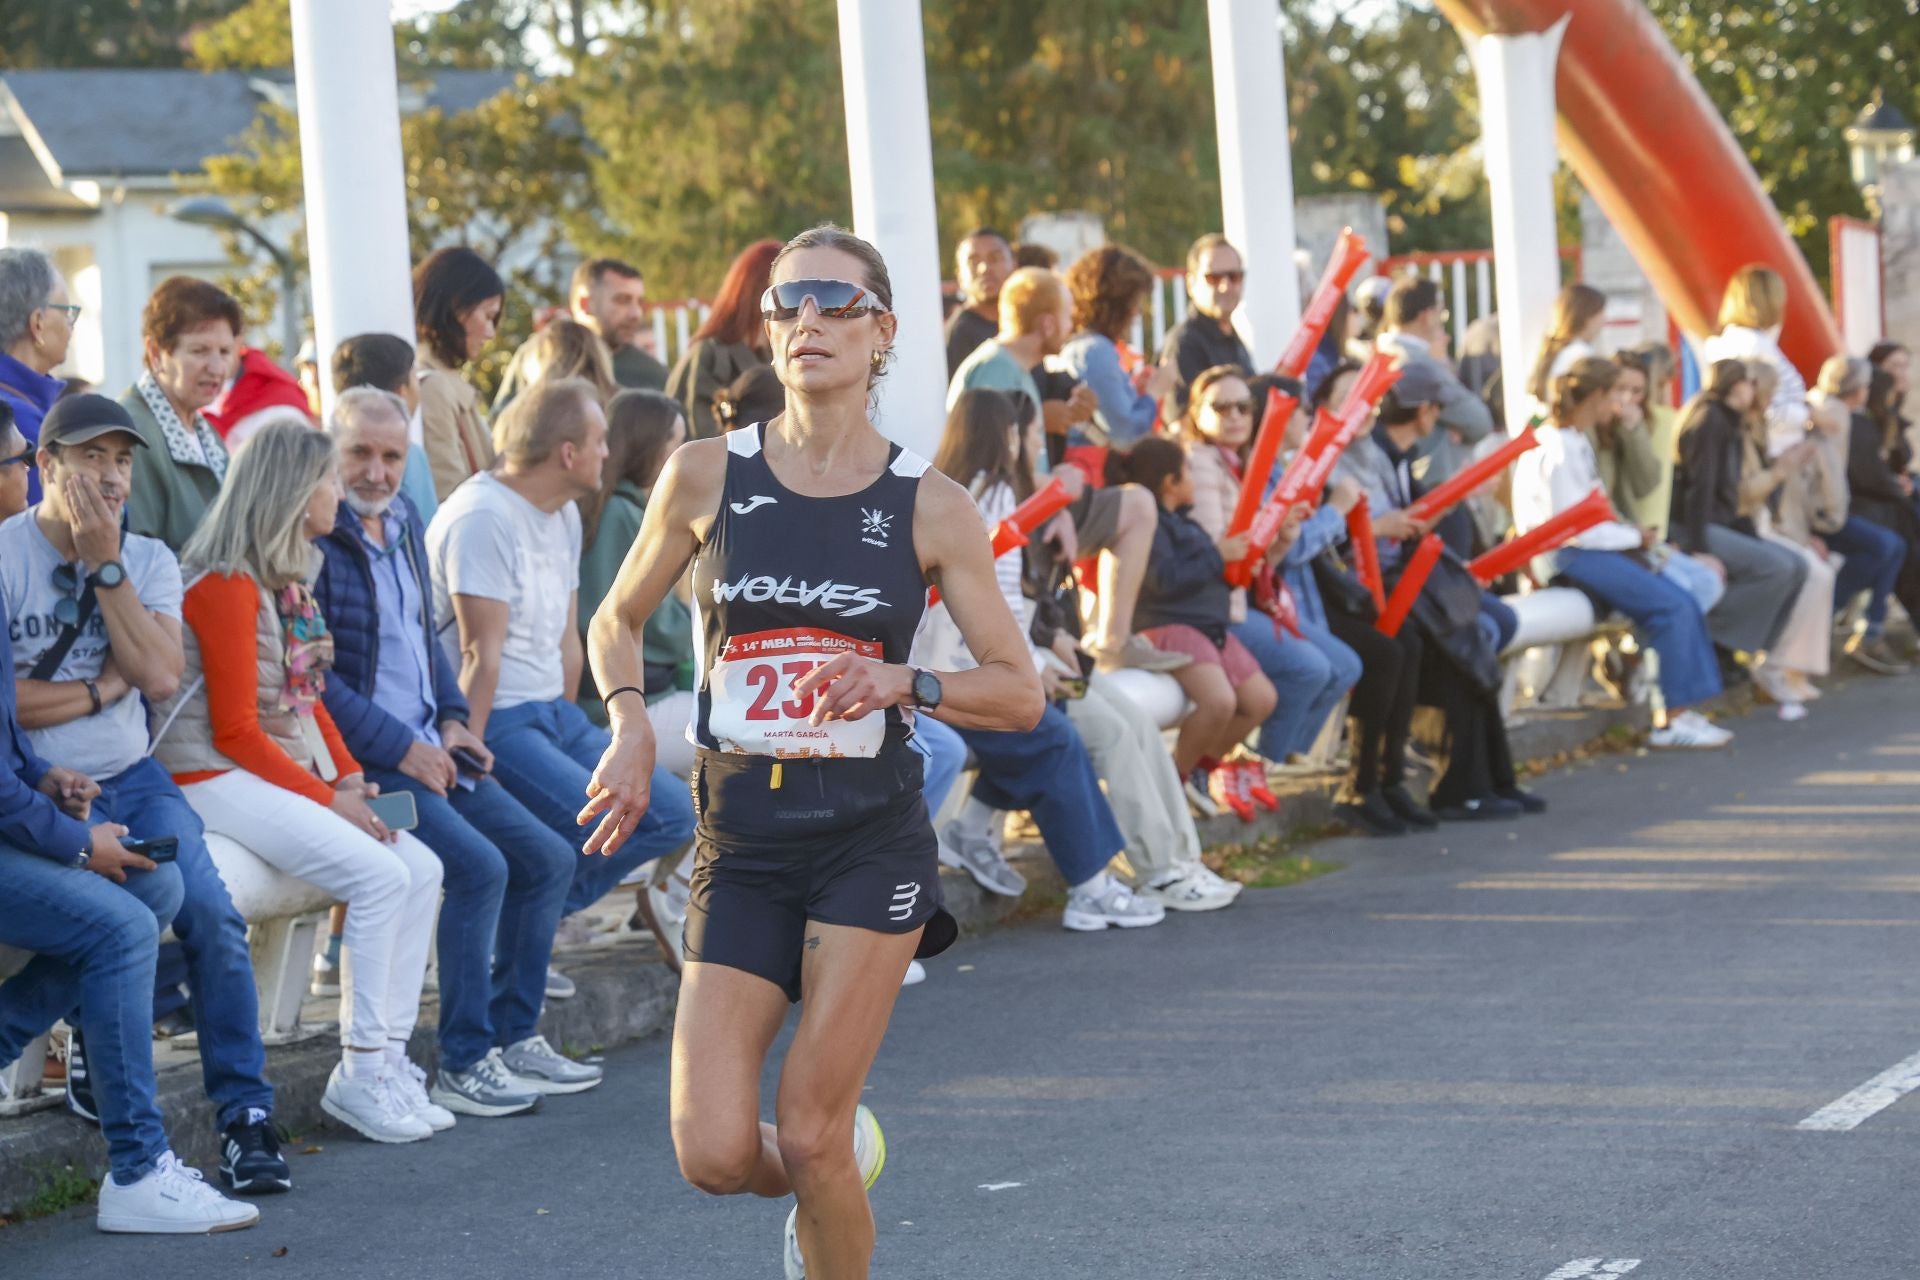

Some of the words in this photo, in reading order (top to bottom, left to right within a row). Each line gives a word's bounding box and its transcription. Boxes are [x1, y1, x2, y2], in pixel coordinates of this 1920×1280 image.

[861, 537, 888, 548] WOLVES
[711, 572, 892, 616] WOLVES
[9, 615, 104, 641] CONR
[761, 637, 795, 650] MBA
[821, 637, 857, 650] GIJÓN
[71, 647, 104, 659] STA
[764, 730, 794, 738] MARTA
[796, 729, 829, 738] GARCÍA
[691, 770, 701, 814] naked
